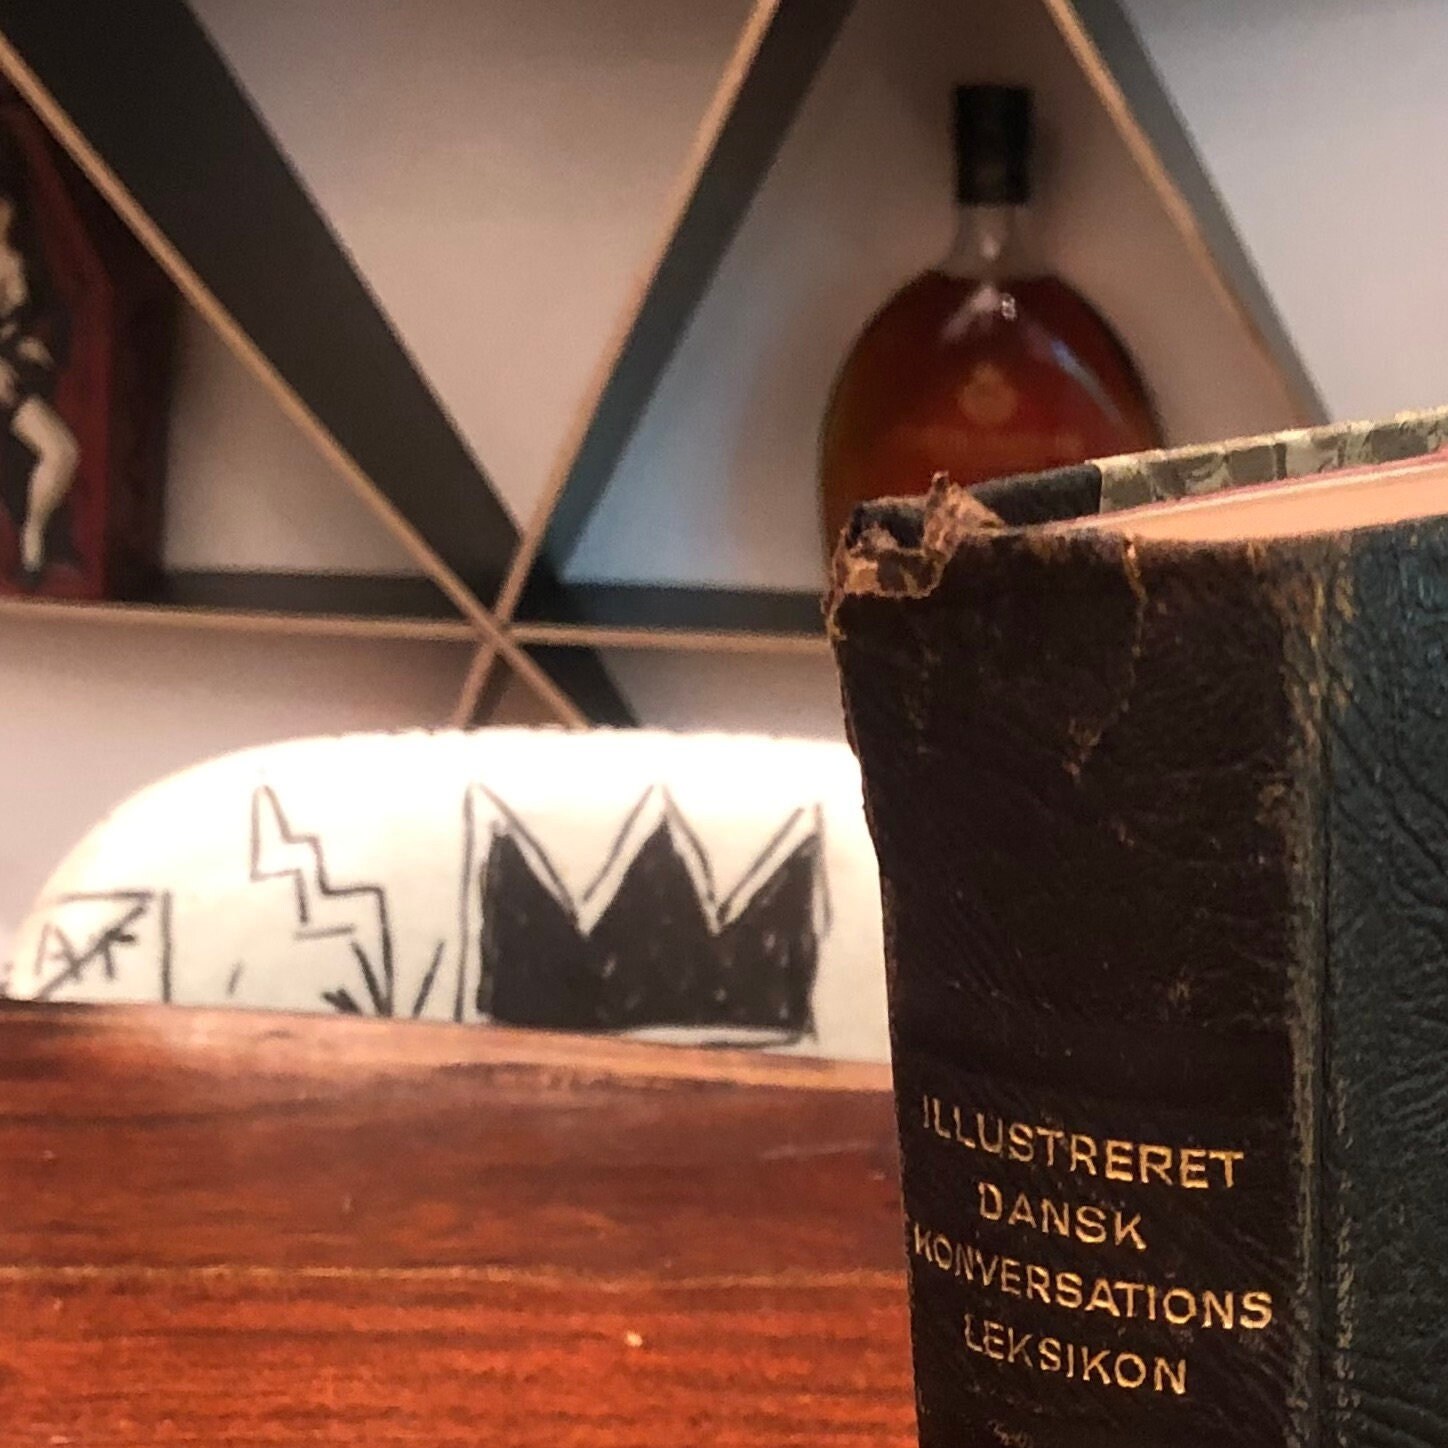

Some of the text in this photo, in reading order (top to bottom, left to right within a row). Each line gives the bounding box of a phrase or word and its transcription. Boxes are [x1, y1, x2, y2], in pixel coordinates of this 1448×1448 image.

[922, 1094, 1244, 1189] ILLUSTRERET
[978, 1181, 1148, 1250] DANSK
[913, 1223, 1274, 1330] KONVERSATIONS
[964, 1313, 1187, 1395] LEKSIKON
